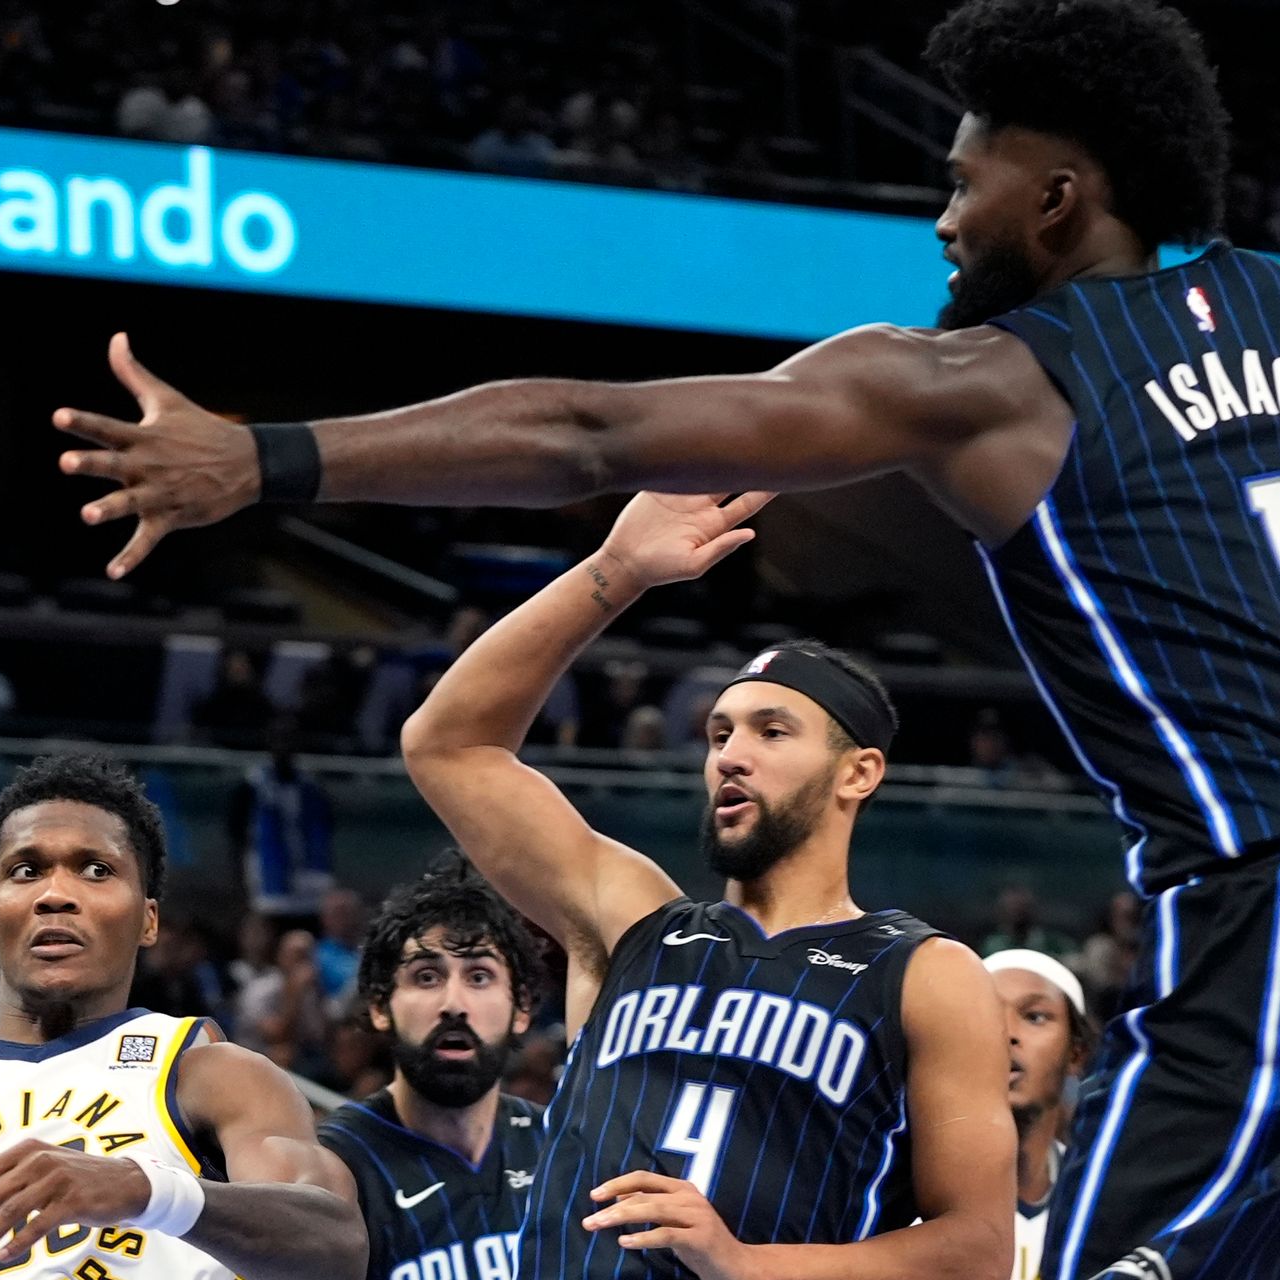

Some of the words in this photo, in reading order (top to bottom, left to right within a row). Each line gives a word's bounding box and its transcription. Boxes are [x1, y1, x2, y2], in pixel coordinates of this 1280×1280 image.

[807, 947, 869, 975] Disney
[594, 982, 867, 1107] ORLANDO
[656, 1081, 740, 1200] 4
